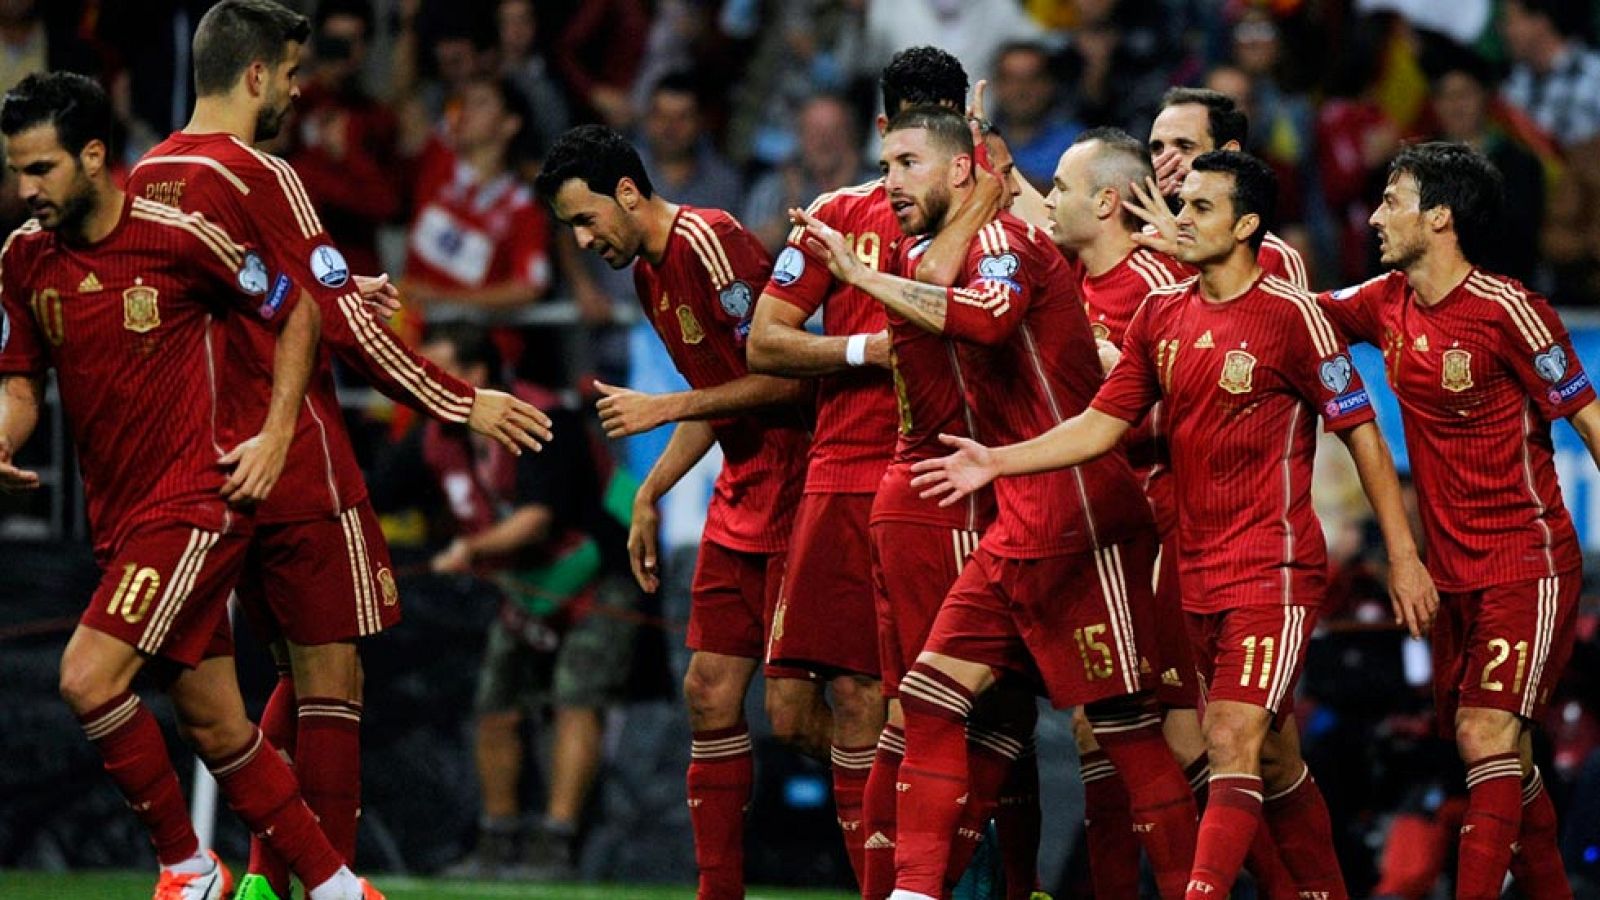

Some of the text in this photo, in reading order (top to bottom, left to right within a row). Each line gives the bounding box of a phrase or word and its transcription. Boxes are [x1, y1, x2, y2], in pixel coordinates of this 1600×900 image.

[106, 563, 160, 624] 10
[1073, 623, 1113, 680] 15
[1240, 635, 1274, 689] 11
[1480, 638, 1528, 694] 21
